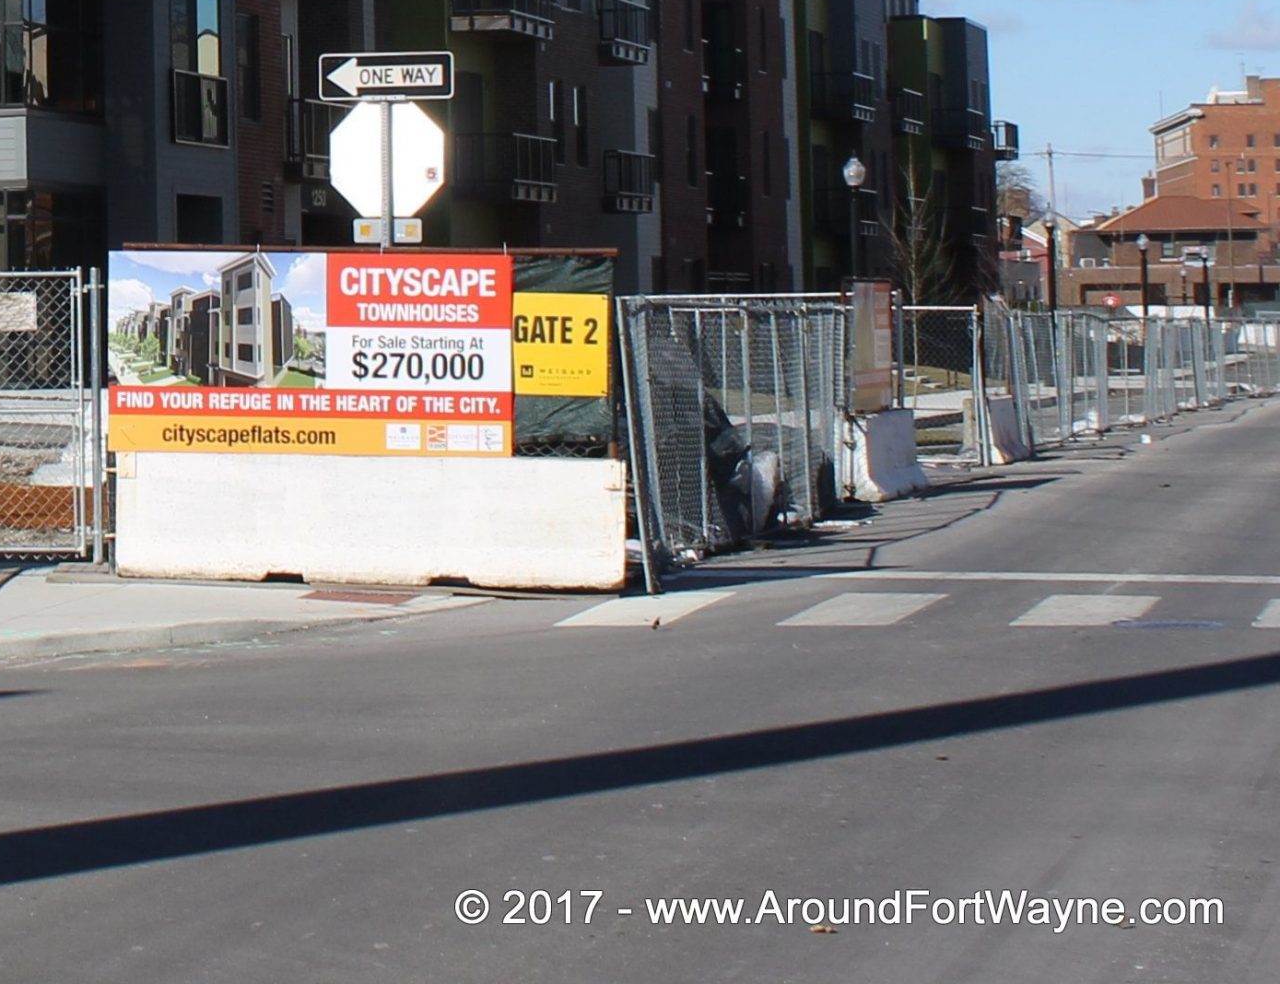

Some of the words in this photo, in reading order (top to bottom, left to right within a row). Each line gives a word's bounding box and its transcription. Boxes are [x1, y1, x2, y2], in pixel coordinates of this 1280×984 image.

[359, 68, 394, 85] ONE
[401, 67, 438, 84] WAY
[340, 267, 496, 297] CITYSCAPE
[357, 302, 480, 323] TOWNHOUSES
[514, 315, 573, 344] GATE
[583, 318, 599, 344] 2
[352, 335, 373, 349] For
[378, 335, 407, 350] Sale
[410, 336, 465, 352] Starting
[469, 336, 484, 350] At
[352, 351, 485, 383] $270,000
[116, 392, 154, 408] FIND
[159, 392, 204, 409] YOUR
[209, 393, 272, 410] REFUGE
[277, 394, 295, 410] IN
[299, 394, 331, 411] THE
[335, 395, 391, 412] HEART
[396, 396, 418, 412] OF
[422, 397, 455, 413] THE
[459, 397, 500, 414] CITY.
[162, 424, 336, 446] cityscapeflats.com
